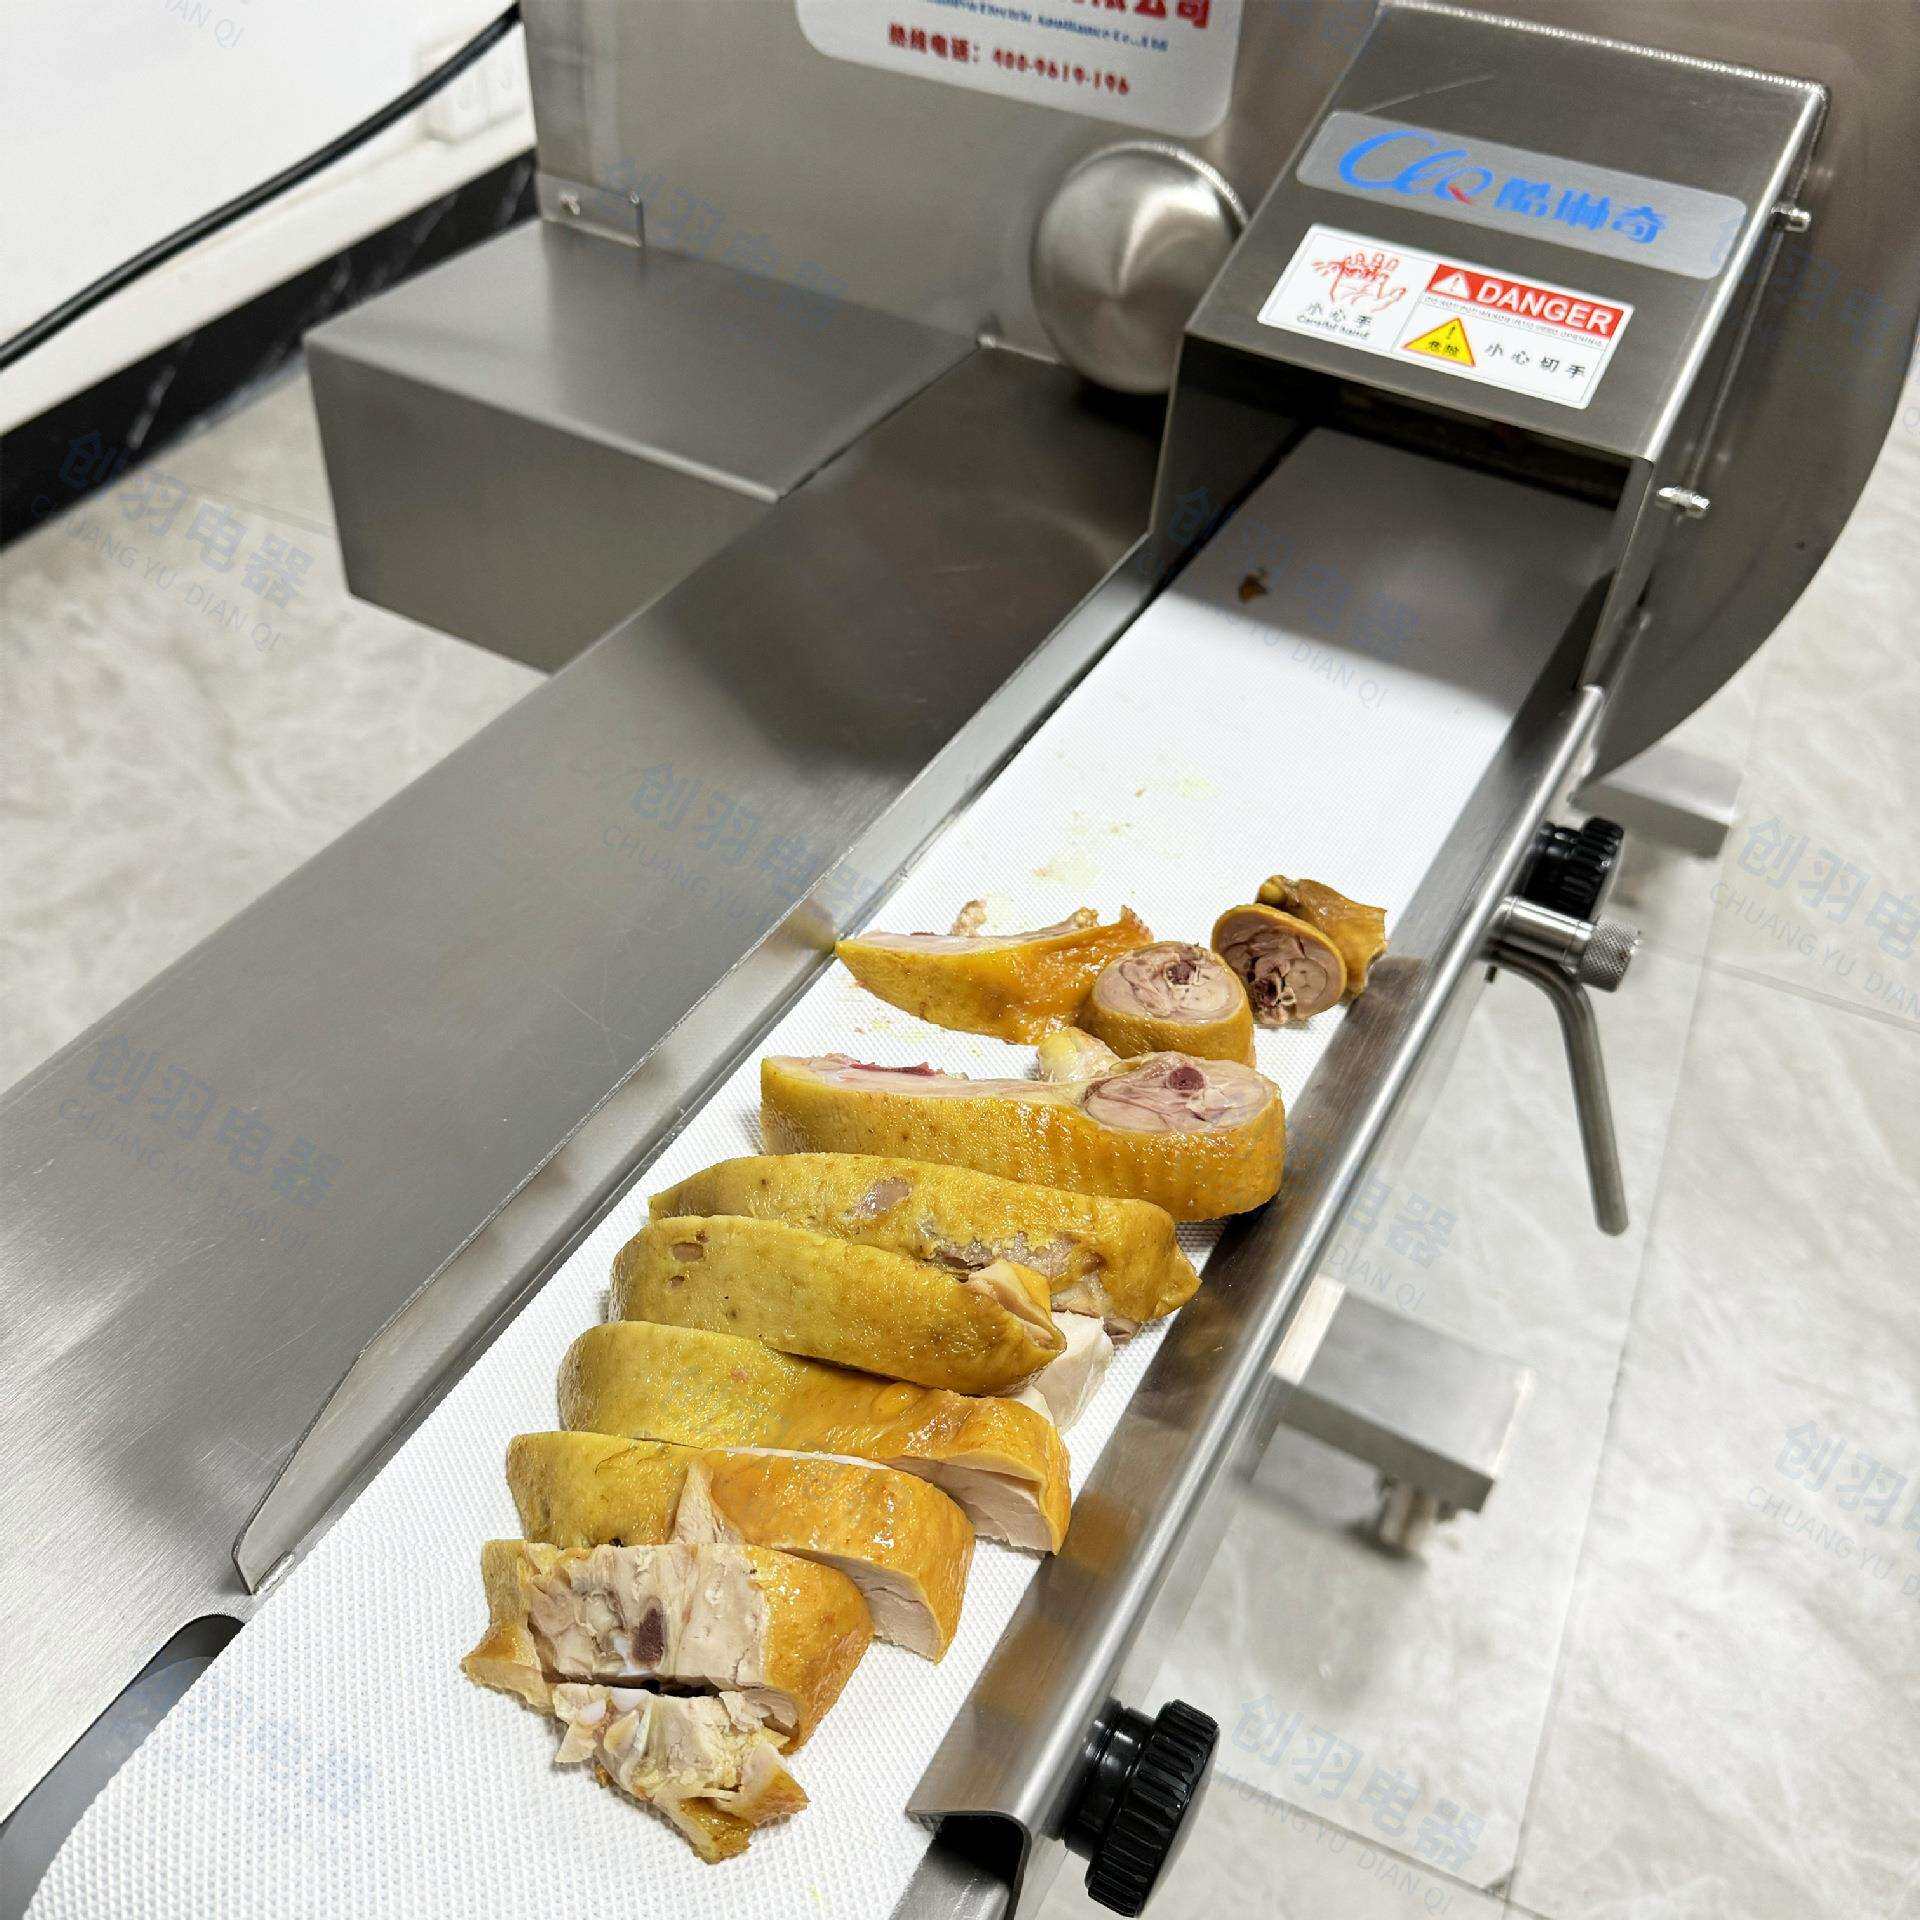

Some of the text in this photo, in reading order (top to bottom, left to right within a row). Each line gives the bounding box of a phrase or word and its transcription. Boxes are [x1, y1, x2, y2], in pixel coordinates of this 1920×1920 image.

[1475, 279, 1616, 336] DANGER
[1485, 342, 1586, 379] 小心切手
